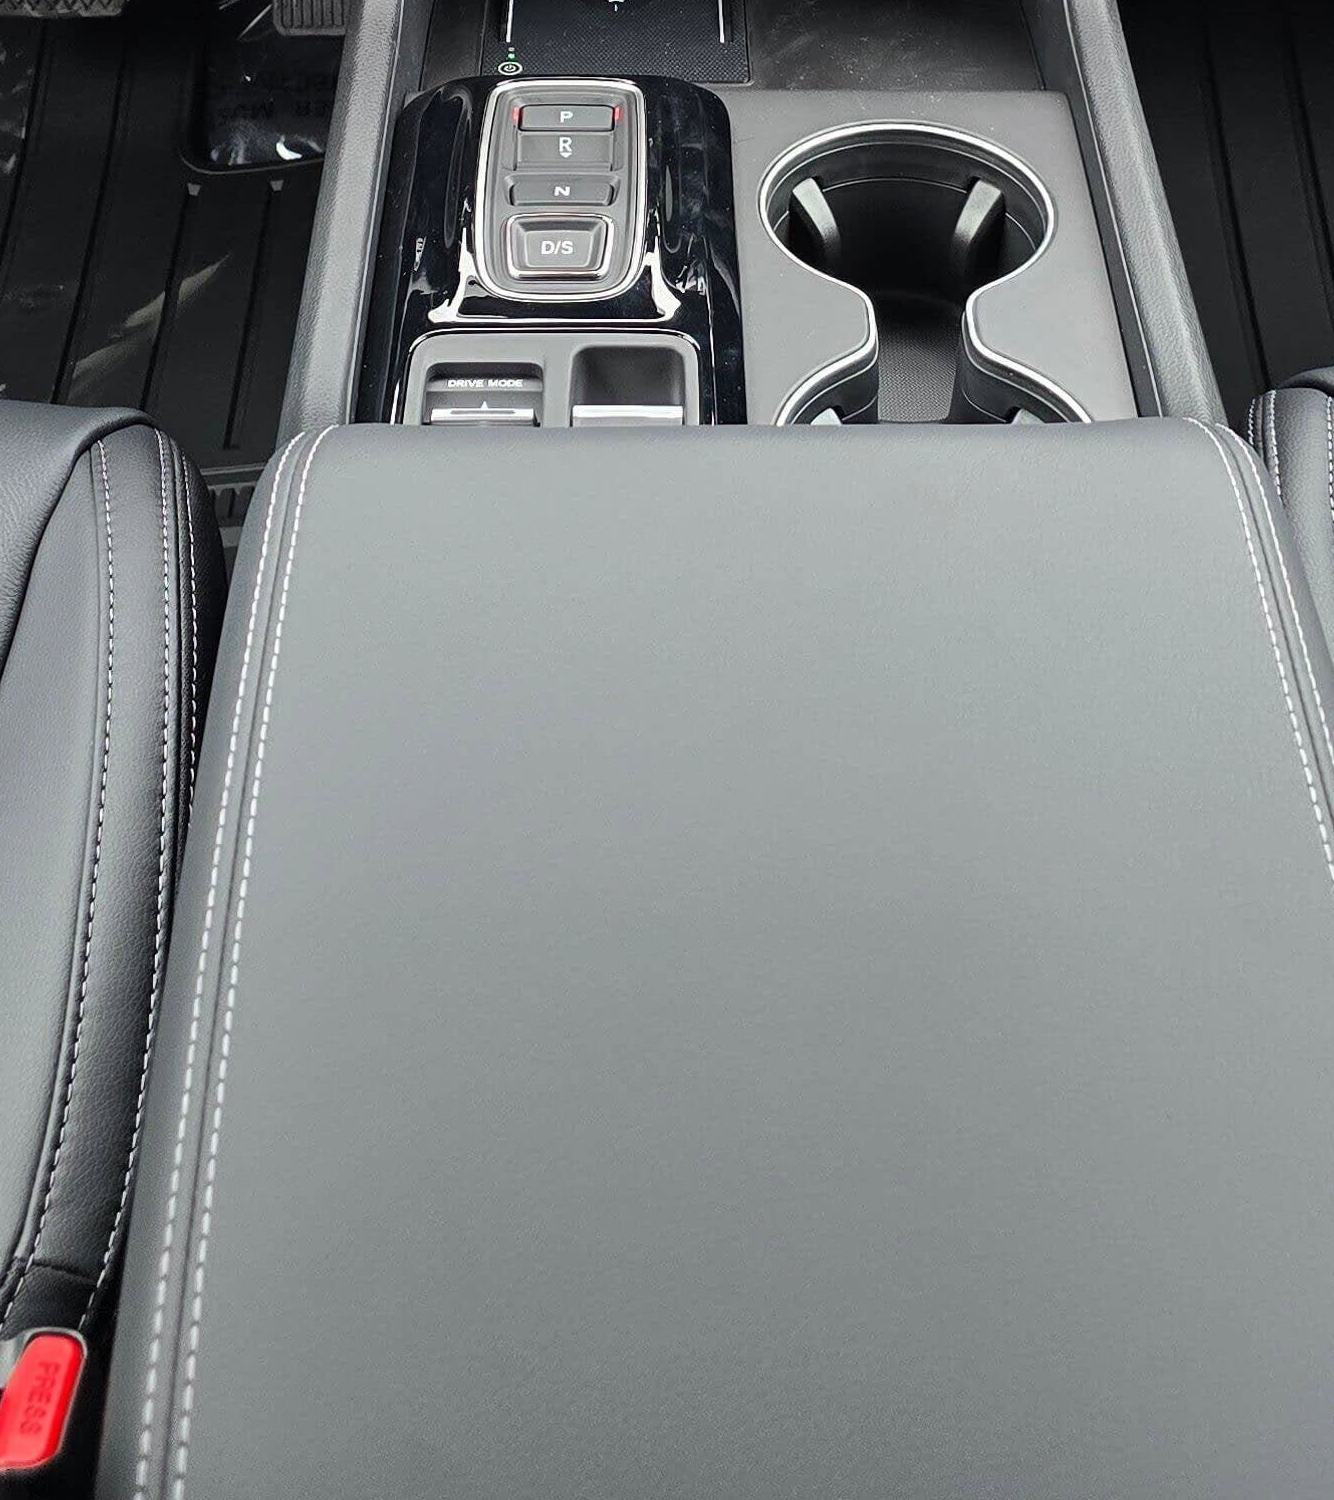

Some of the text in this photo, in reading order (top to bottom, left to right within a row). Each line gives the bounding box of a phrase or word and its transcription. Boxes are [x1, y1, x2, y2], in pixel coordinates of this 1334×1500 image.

[560, 110, 574, 123] P
[559, 137, 572, 152] R
[554, 186, 571, 197] N
[541, 240, 574, 255] D/S
[448, 379, 523, 388] DRIVE MODE
